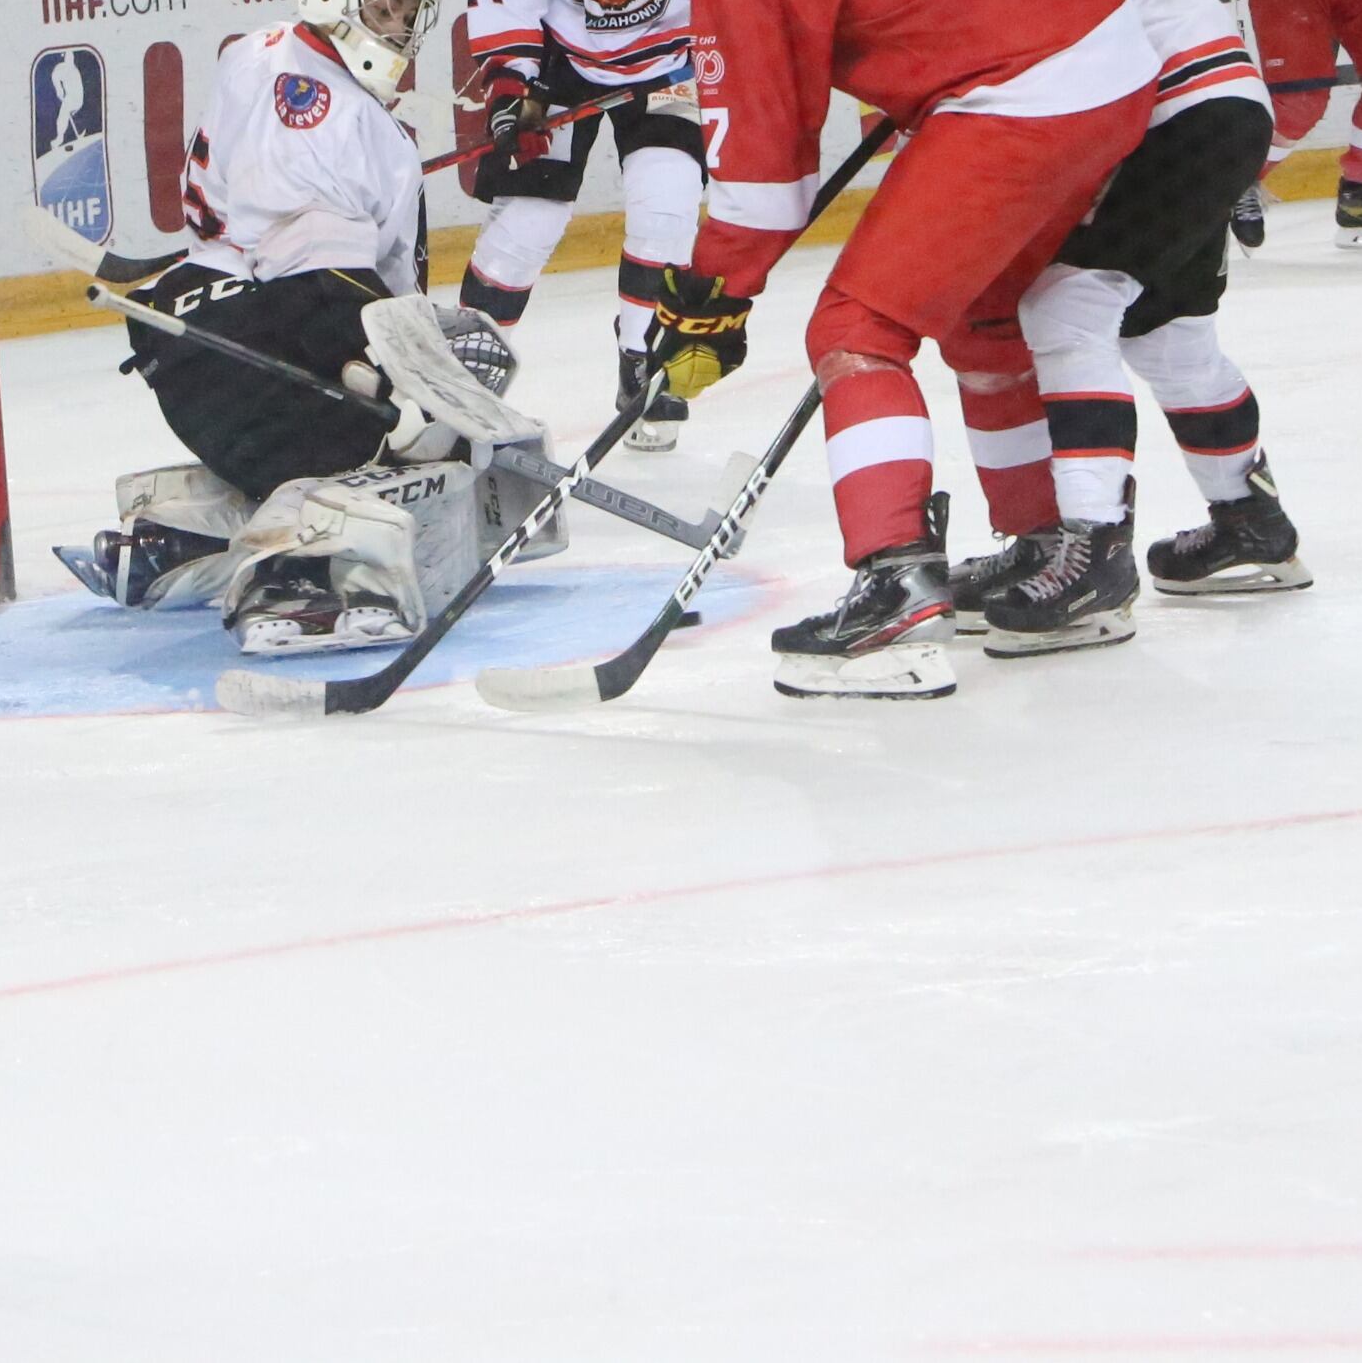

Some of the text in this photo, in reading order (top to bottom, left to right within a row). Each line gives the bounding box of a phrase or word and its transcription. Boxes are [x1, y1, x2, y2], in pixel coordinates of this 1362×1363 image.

[173, 276, 251, 318] CC
[655, 301, 750, 335] CCM
[377, 473, 446, 506] CCM
[674, 465, 769, 612] BAUER
